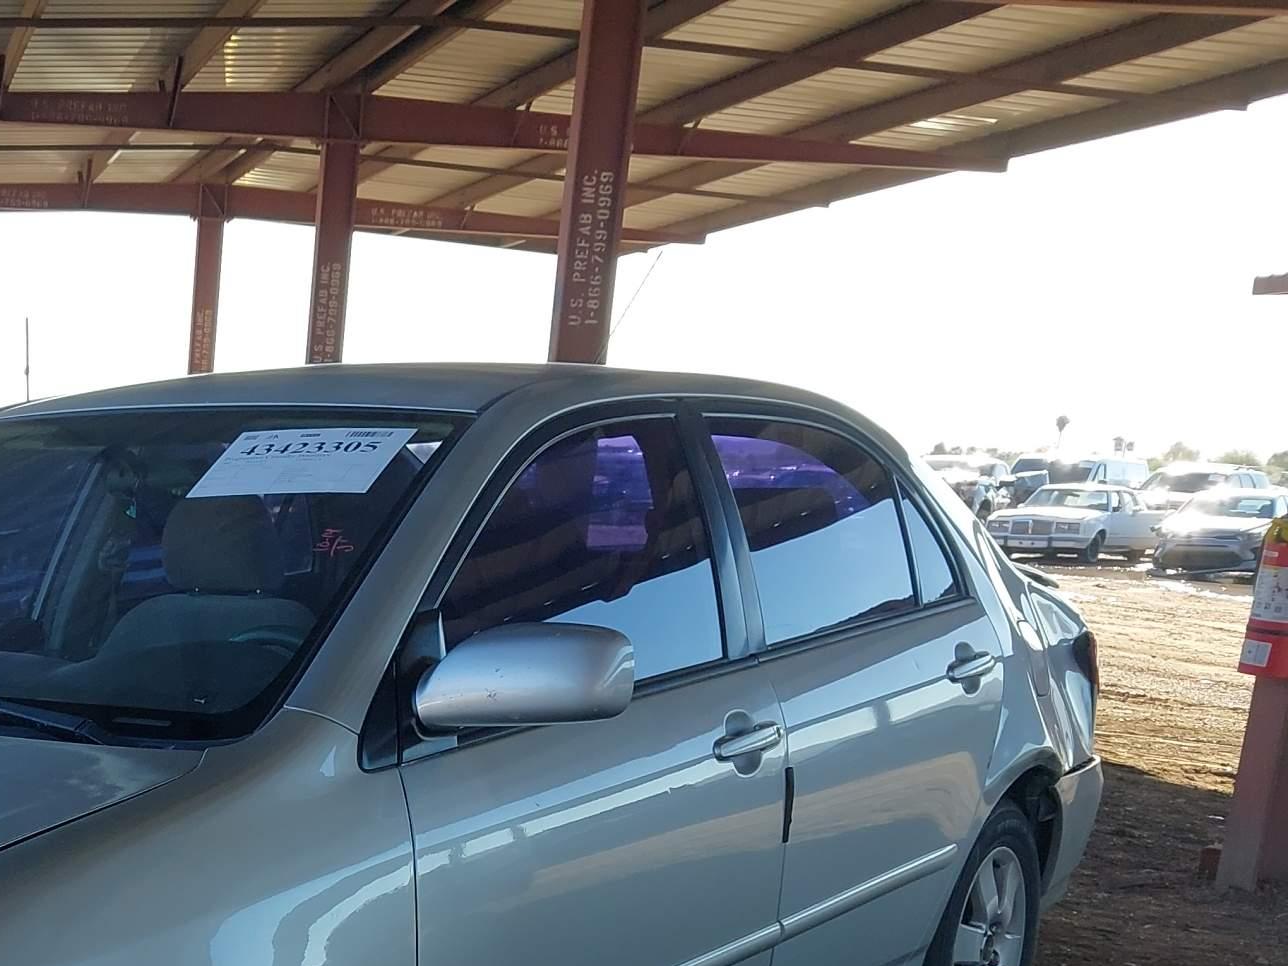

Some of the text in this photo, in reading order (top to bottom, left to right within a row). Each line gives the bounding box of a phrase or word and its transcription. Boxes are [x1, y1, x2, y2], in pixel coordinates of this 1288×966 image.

[568, 168, 600, 326] U.S. PREFAB INC.
[584, 171, 615, 325] 1-866-799-0969
[315, 289, 329, 336] PREFAB
[240, 441, 382, 456] 43423305
